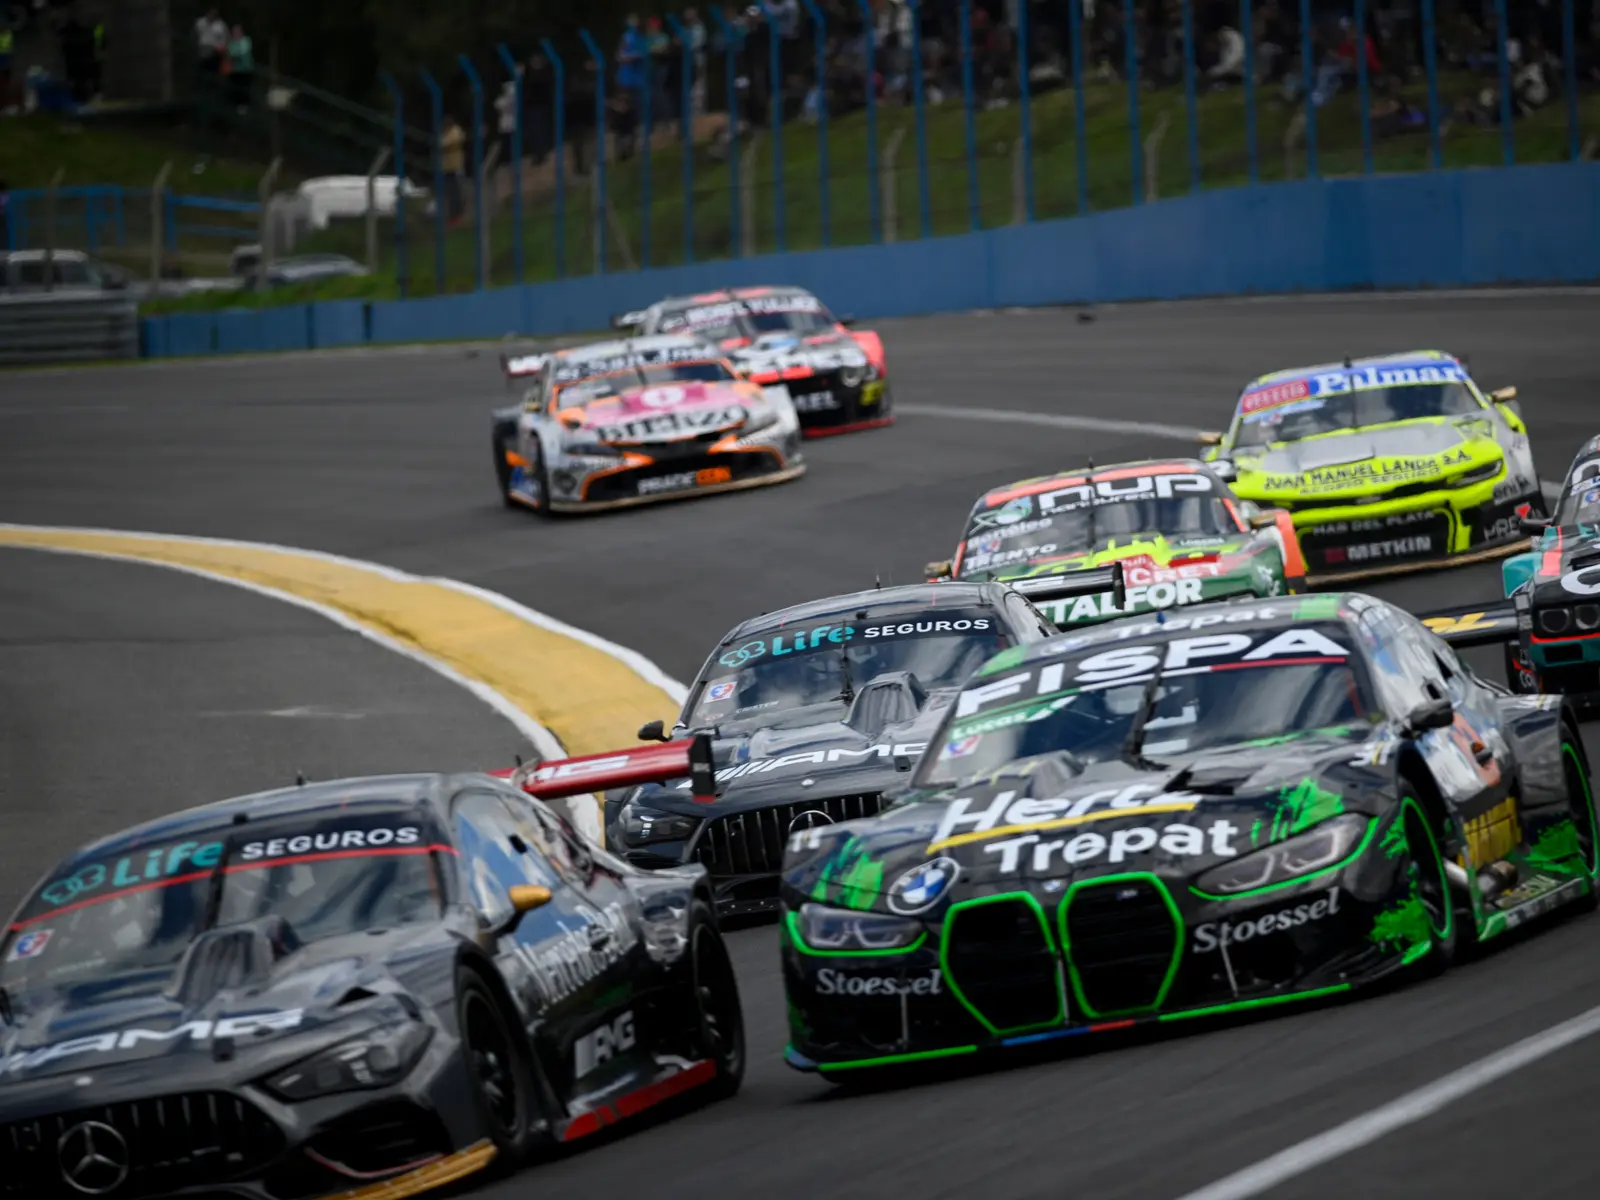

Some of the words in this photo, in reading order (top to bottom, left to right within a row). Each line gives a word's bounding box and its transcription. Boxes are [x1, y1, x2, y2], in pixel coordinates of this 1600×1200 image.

[1310, 464, 1376, 486] MANUEL
[771, 625, 856, 657] Life
[863, 618, 991, 639] SEGUROS
[955, 628, 1351, 718] FISPA
[112, 842, 224, 888] Life
[241, 827, 420, 861] SEGUROS
[984, 818, 1238, 873] Trepat
[1192, 887, 1341, 954] Stoessel
